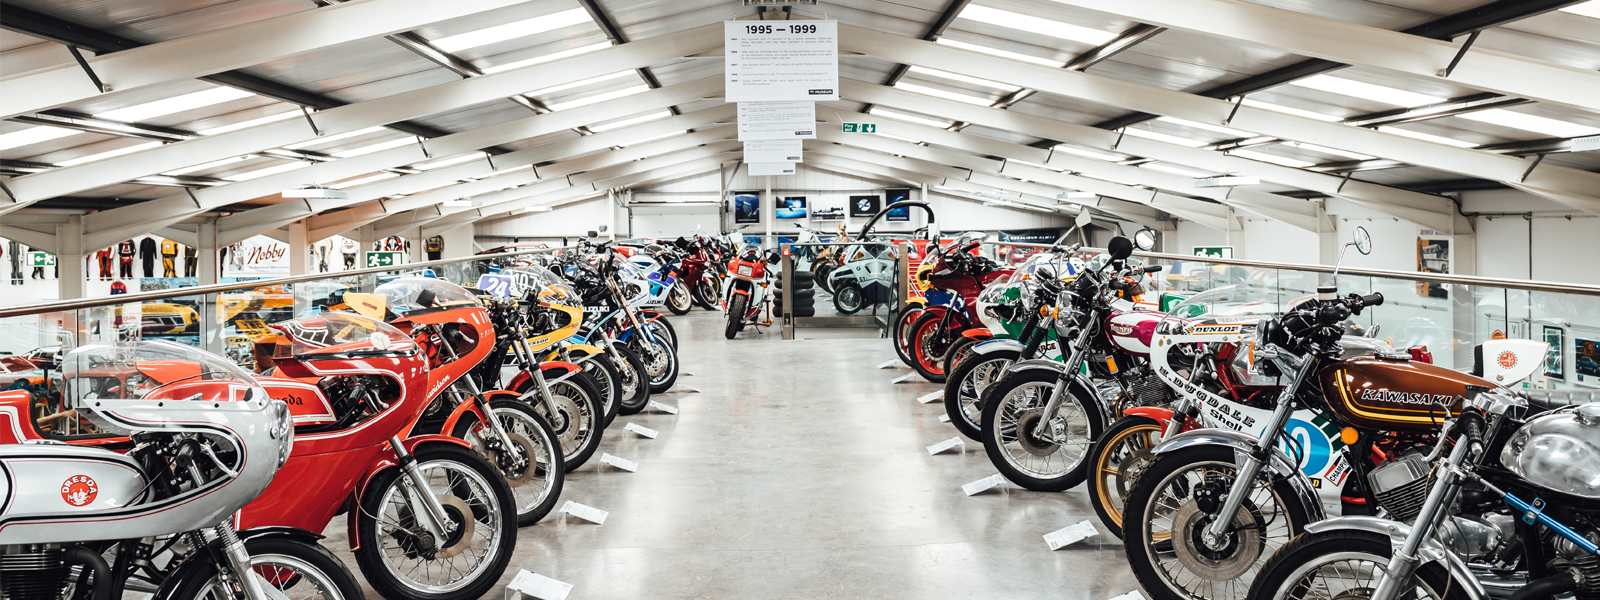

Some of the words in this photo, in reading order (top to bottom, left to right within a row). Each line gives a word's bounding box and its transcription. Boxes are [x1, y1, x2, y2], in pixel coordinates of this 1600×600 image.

[745, 25, 772, 34] 1995
[789, 24, 817, 34] 1999
[246, 243, 286, 265] Nobby
[484, 277, 509, 298] 24
[1110, 323, 1133, 335] TRIUMPH
[1361, 388, 1452, 406] KAWASAKI
[1210, 409, 1242, 431] Shell
[62, 476, 97, 495] DRESDA
